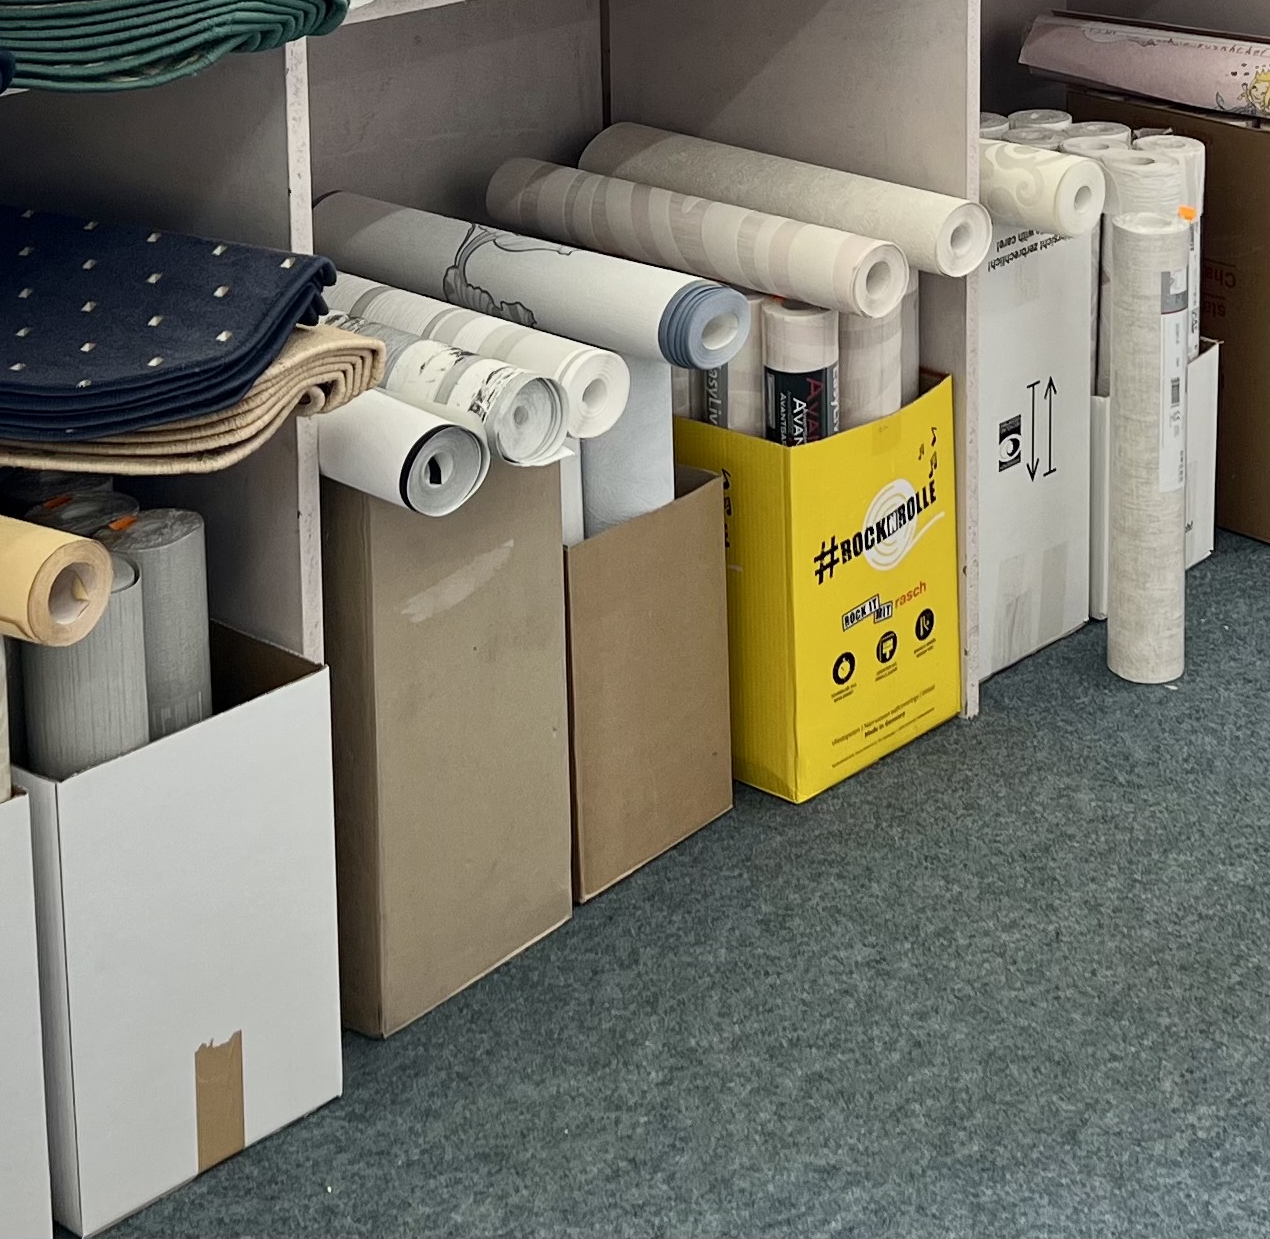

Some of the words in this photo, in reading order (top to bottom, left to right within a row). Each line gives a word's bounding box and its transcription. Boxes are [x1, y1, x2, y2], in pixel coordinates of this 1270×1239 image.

[704, 368, 723, 426] asyLiv
[844, 608, 867, 629] ROCK
[869, 598, 878, 613] IT
[894, 581, 927, 609] rasch
